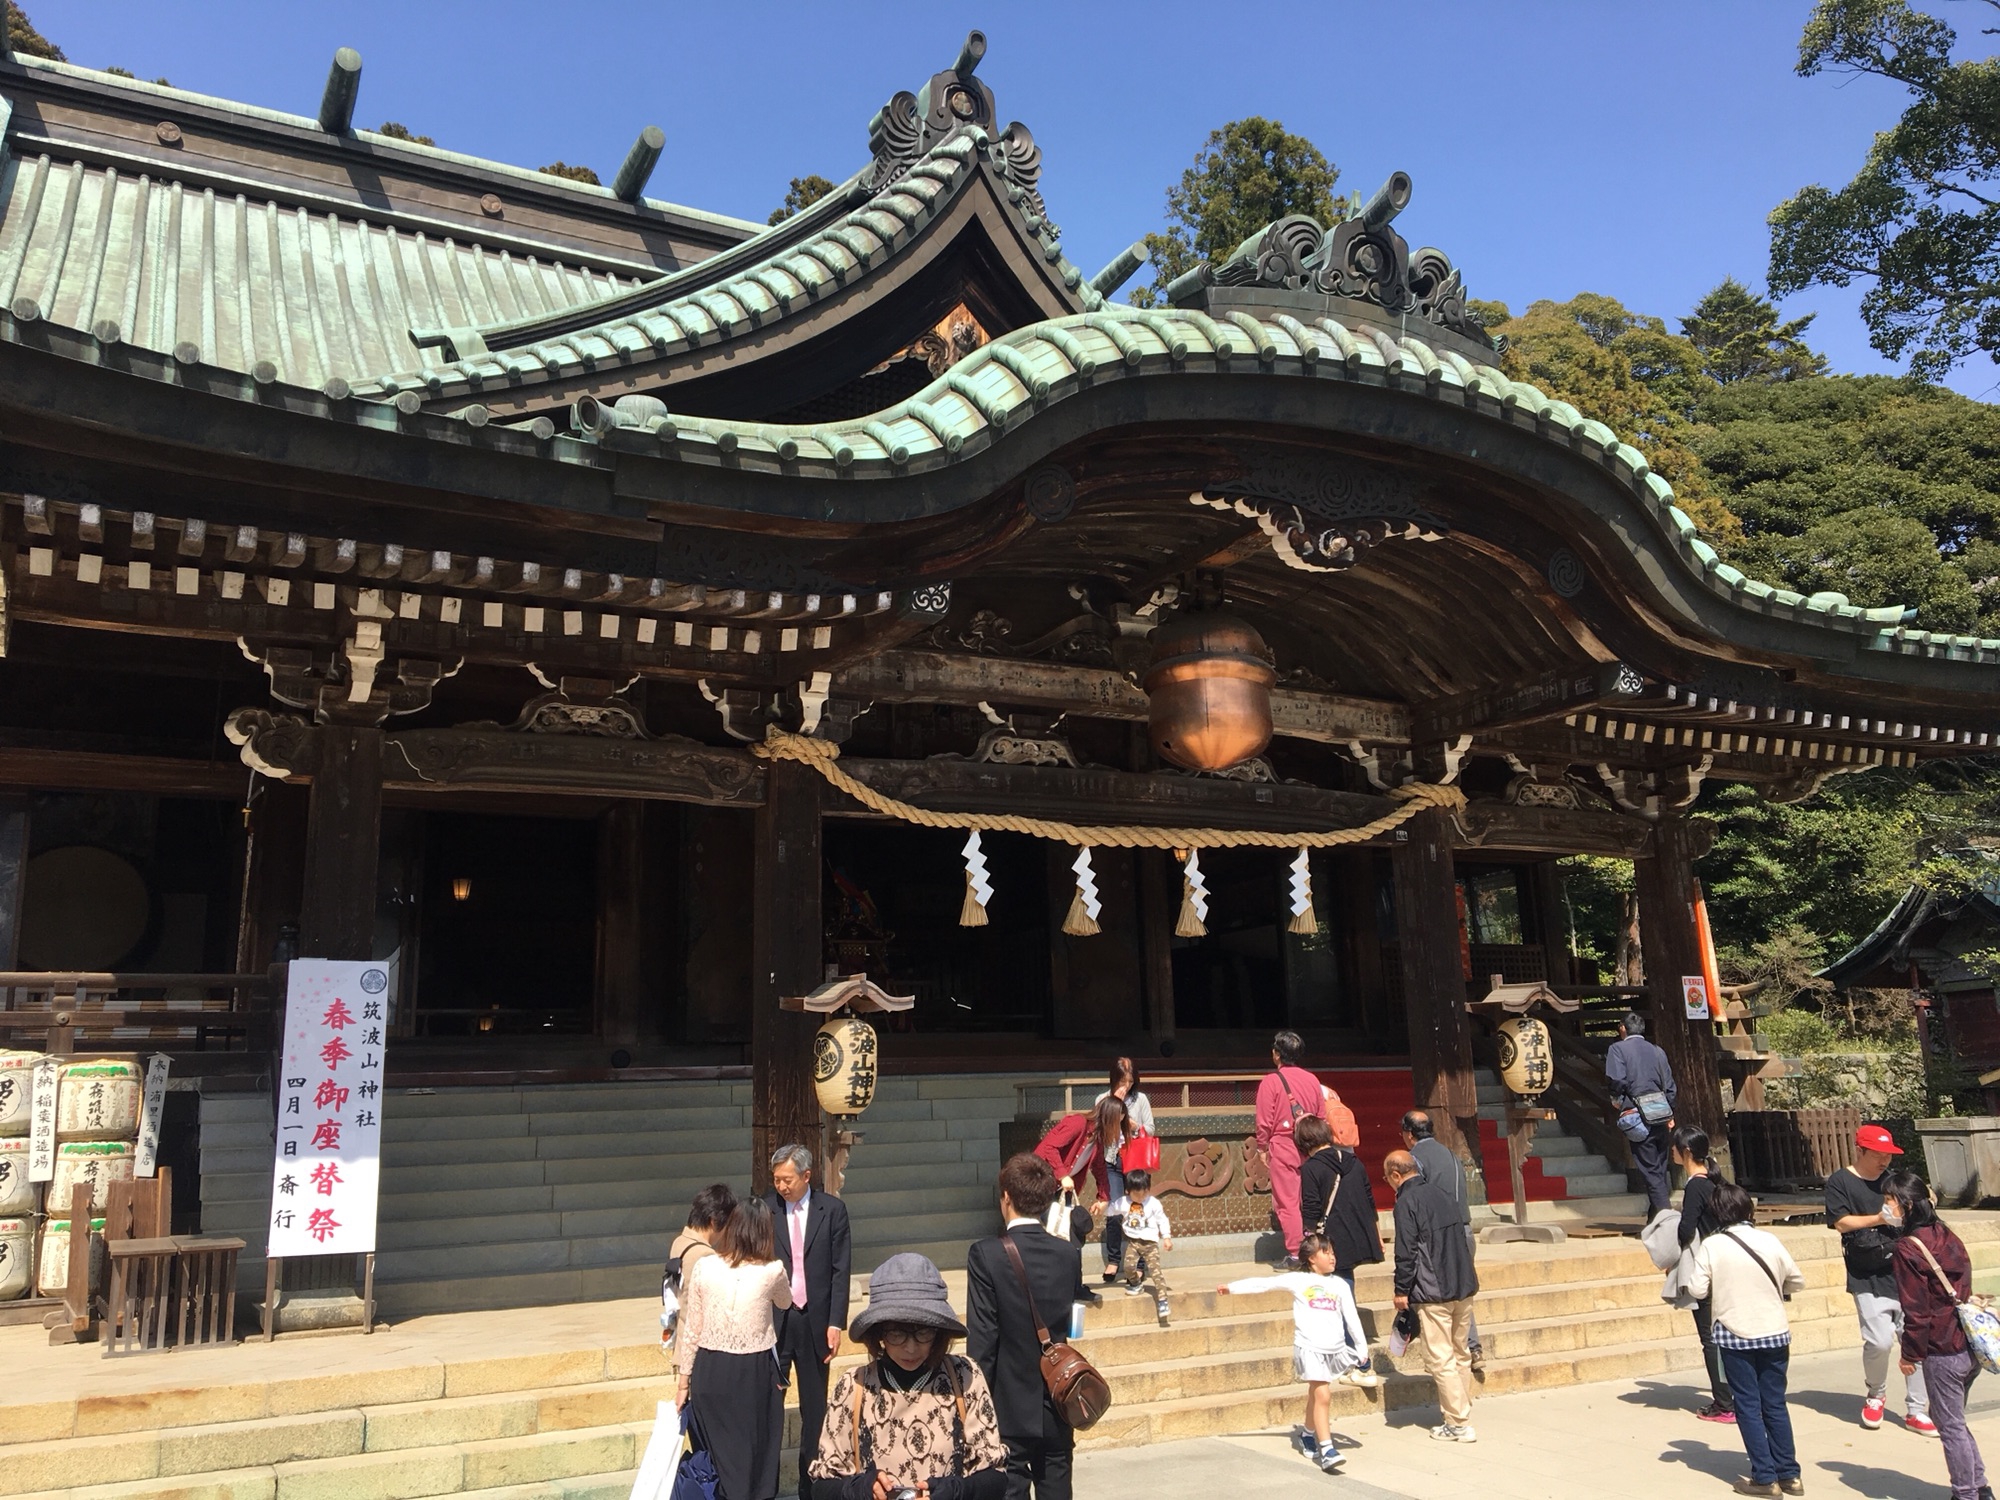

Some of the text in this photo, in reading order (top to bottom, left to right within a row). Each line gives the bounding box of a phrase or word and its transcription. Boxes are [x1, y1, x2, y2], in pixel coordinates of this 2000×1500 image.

[354, 1002, 382, 1128] 筑波山神社
[844, 1021, 875, 1108] 筑波山神社
[1517, 1019, 1549, 1090] 筑波山神社
[305, 998, 356, 1243] 春季御座替祭
